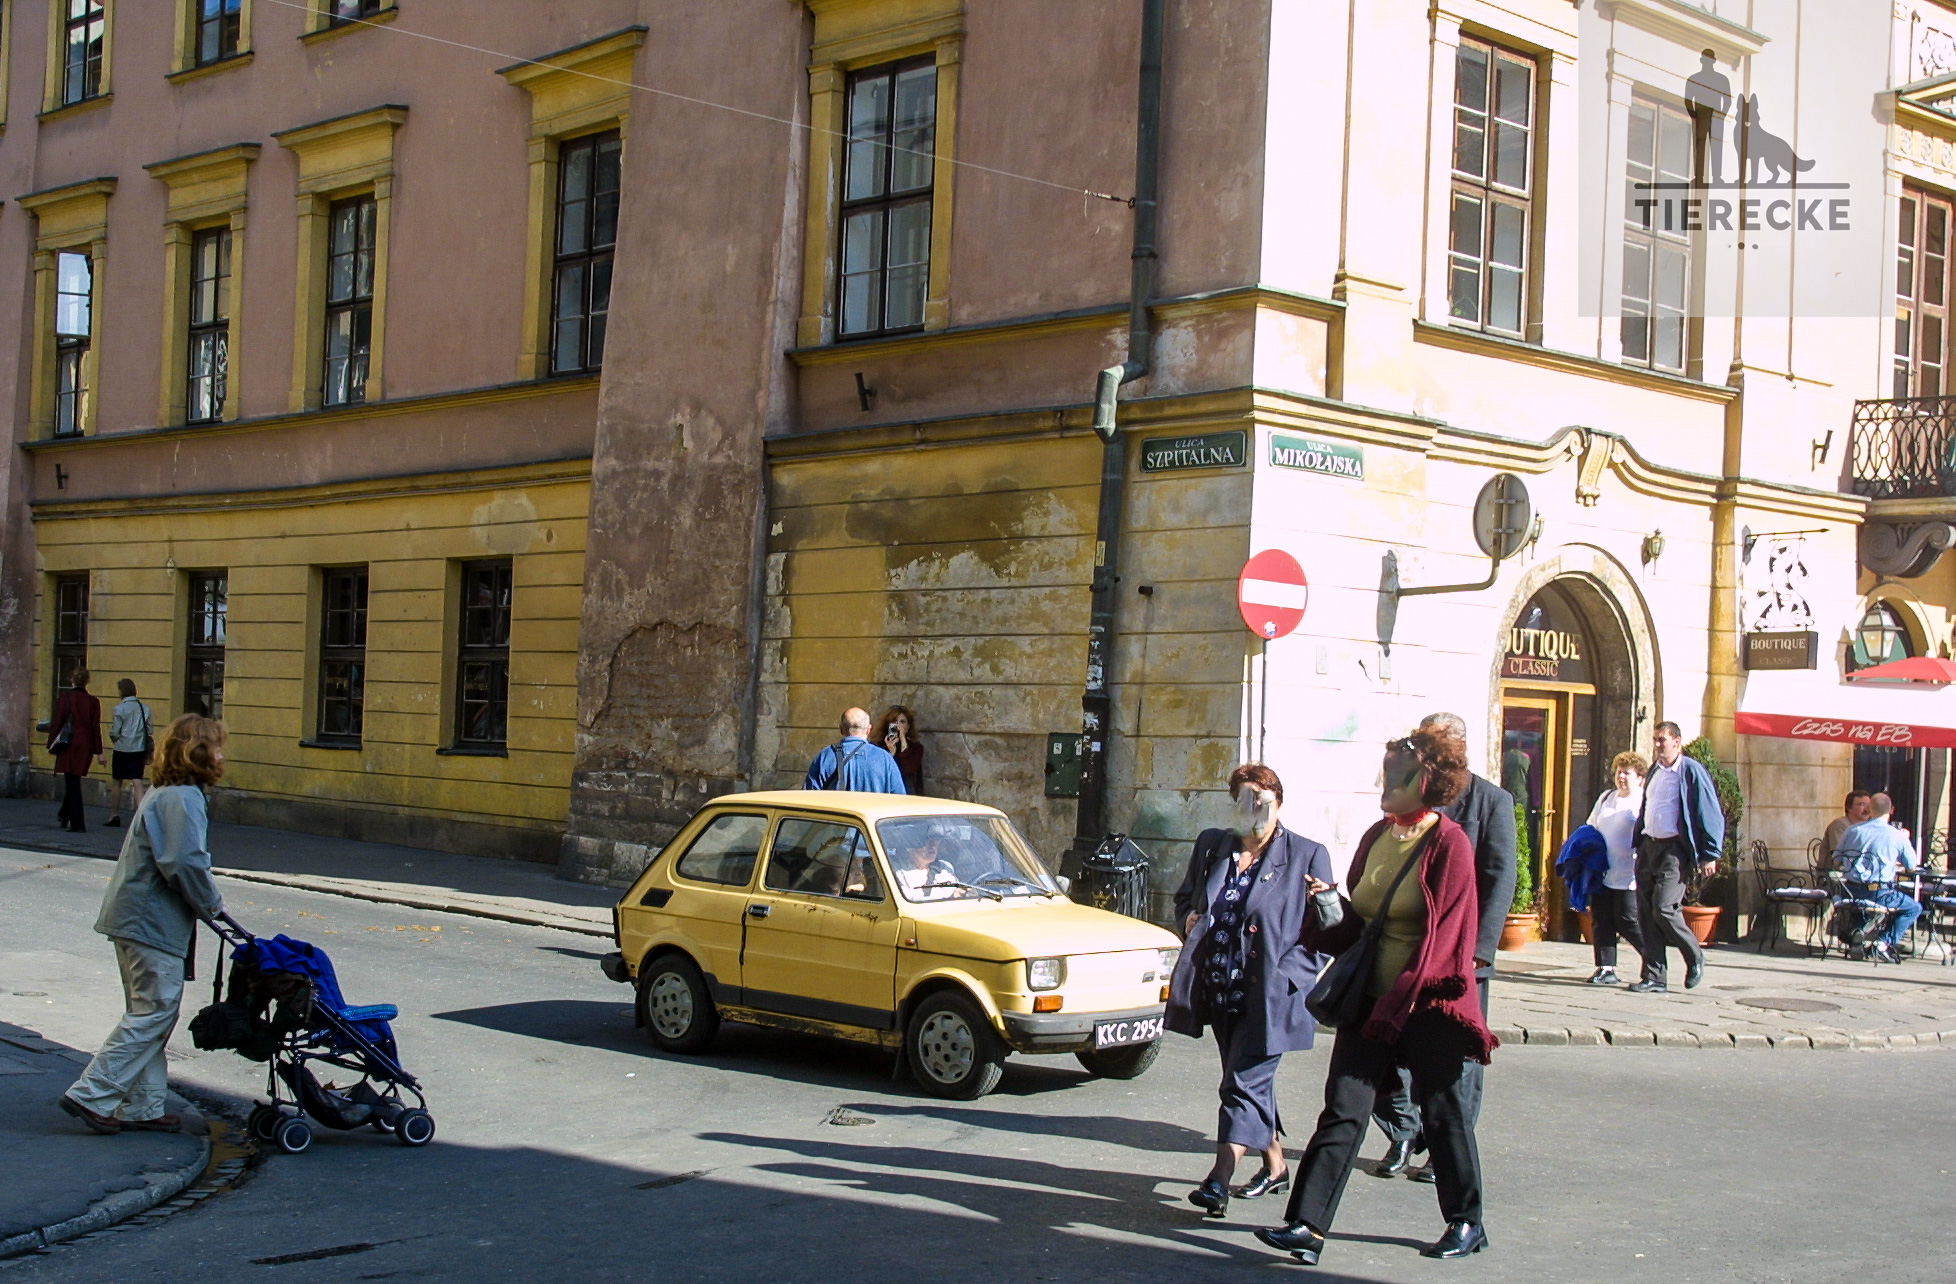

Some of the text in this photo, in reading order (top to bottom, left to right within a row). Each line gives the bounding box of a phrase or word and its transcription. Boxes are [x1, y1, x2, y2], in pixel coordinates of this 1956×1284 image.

[1175, 439, 1204, 448] ULICA
[1306, 441, 1334, 454] ULICA
[1146, 447, 1235, 468] SZPITALNA
[1274, 447, 1362, 477] MIKOŁAJSKA
[1751, 638, 1806, 651] BOUTIQUE
[1510, 660, 1560, 676] CLASSIC
[1848, 725, 1875, 741] na
[1876, 725, 1912, 743] EB
[1098, 1017, 1164, 1045] KKC 2954
